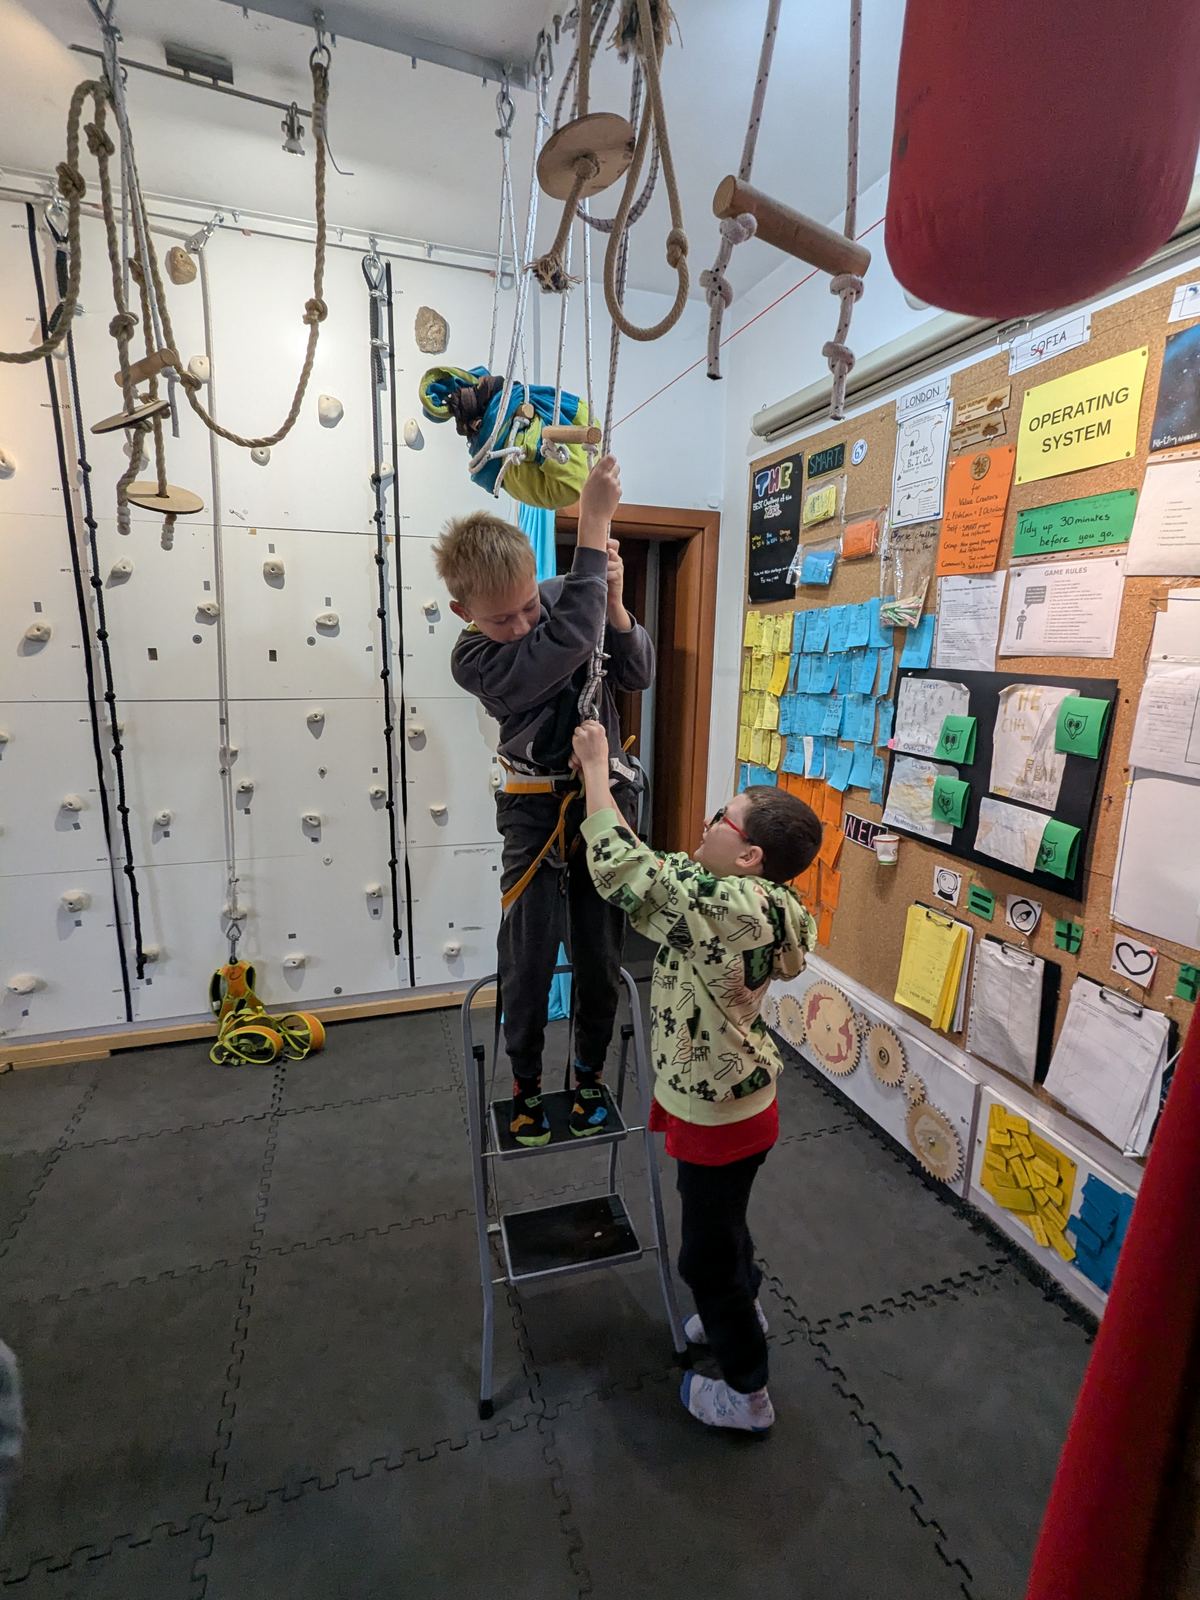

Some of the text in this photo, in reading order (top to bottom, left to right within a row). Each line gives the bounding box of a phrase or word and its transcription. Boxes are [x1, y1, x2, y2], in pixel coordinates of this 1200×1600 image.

[1030, 331, 1067, 357] SOFIA
[905, 386, 940, 409] LONDON
[1028, 387, 1129, 432] OPERATING
[1041, 418, 1112, 454] SYSTEM
[909, 446, 928, 458] Awards
[755, 462, 794, 497] THE
[971, 483, 981, 495] for
[959, 497, 973, 506] Value
[1019, 519, 1037, 538] Tidy
[1043, 523, 1053, 534] up
[1040, 530, 1114, 547] before you go.
[1044, 566, 1087, 576] GAME RULES
